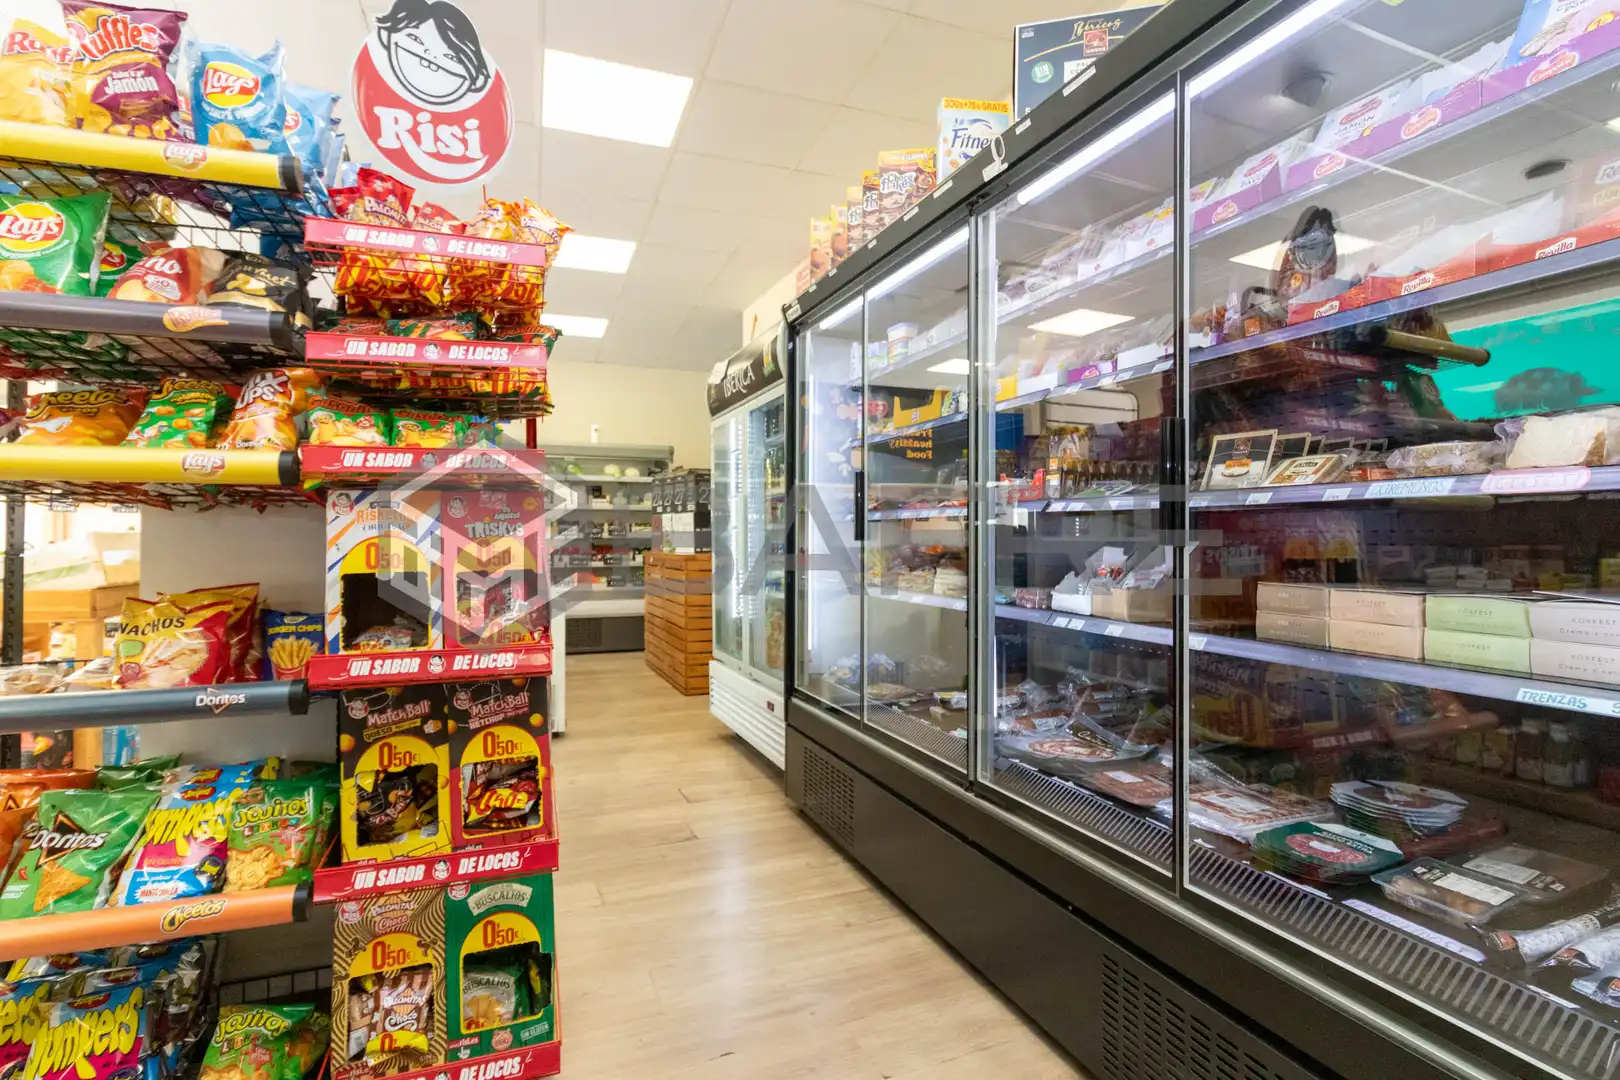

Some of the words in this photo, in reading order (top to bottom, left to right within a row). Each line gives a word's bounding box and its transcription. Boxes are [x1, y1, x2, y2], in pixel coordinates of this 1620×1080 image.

[373, 106, 488, 179] Risi
[345, 228, 368, 242] UN
[367, 230, 416, 248] SABOR
[447, 239, 466, 254] DE
[467, 241, 509, 258] LOCOS
[346, 340, 368, 354] UN
[368, 341, 417, 358] SABOR
[448, 344, 467, 360] DE
[467, 345, 509, 361] LOCOS
[343, 452, 363, 467] UN
[365, 452, 413, 468] SABOR
[446, 454, 466, 468] DE
[117, 616, 186, 638] NACHOS
[350, 659, 371, 677] UN
[372, 657, 420, 674] SABOR
[453, 654, 472, 670] DE
[472, 652, 515, 669] LOCOS
[196, 692, 246, 707] Doritos
[1521, 690, 1588, 709] TRENZAS
[364, 727, 393, 741] QUESO
[28, 829, 110, 850] Doritos
[354, 873, 377, 890] UN
[379, 865, 425, 886] SABOR
[457, 857, 477, 876] DE
[477, 851, 520, 871] LOCOS
[162, 900, 225, 931] Cheetos
[460, 1061, 479, 1080] DE
[479, 1056, 521, 1078] LOCOS
